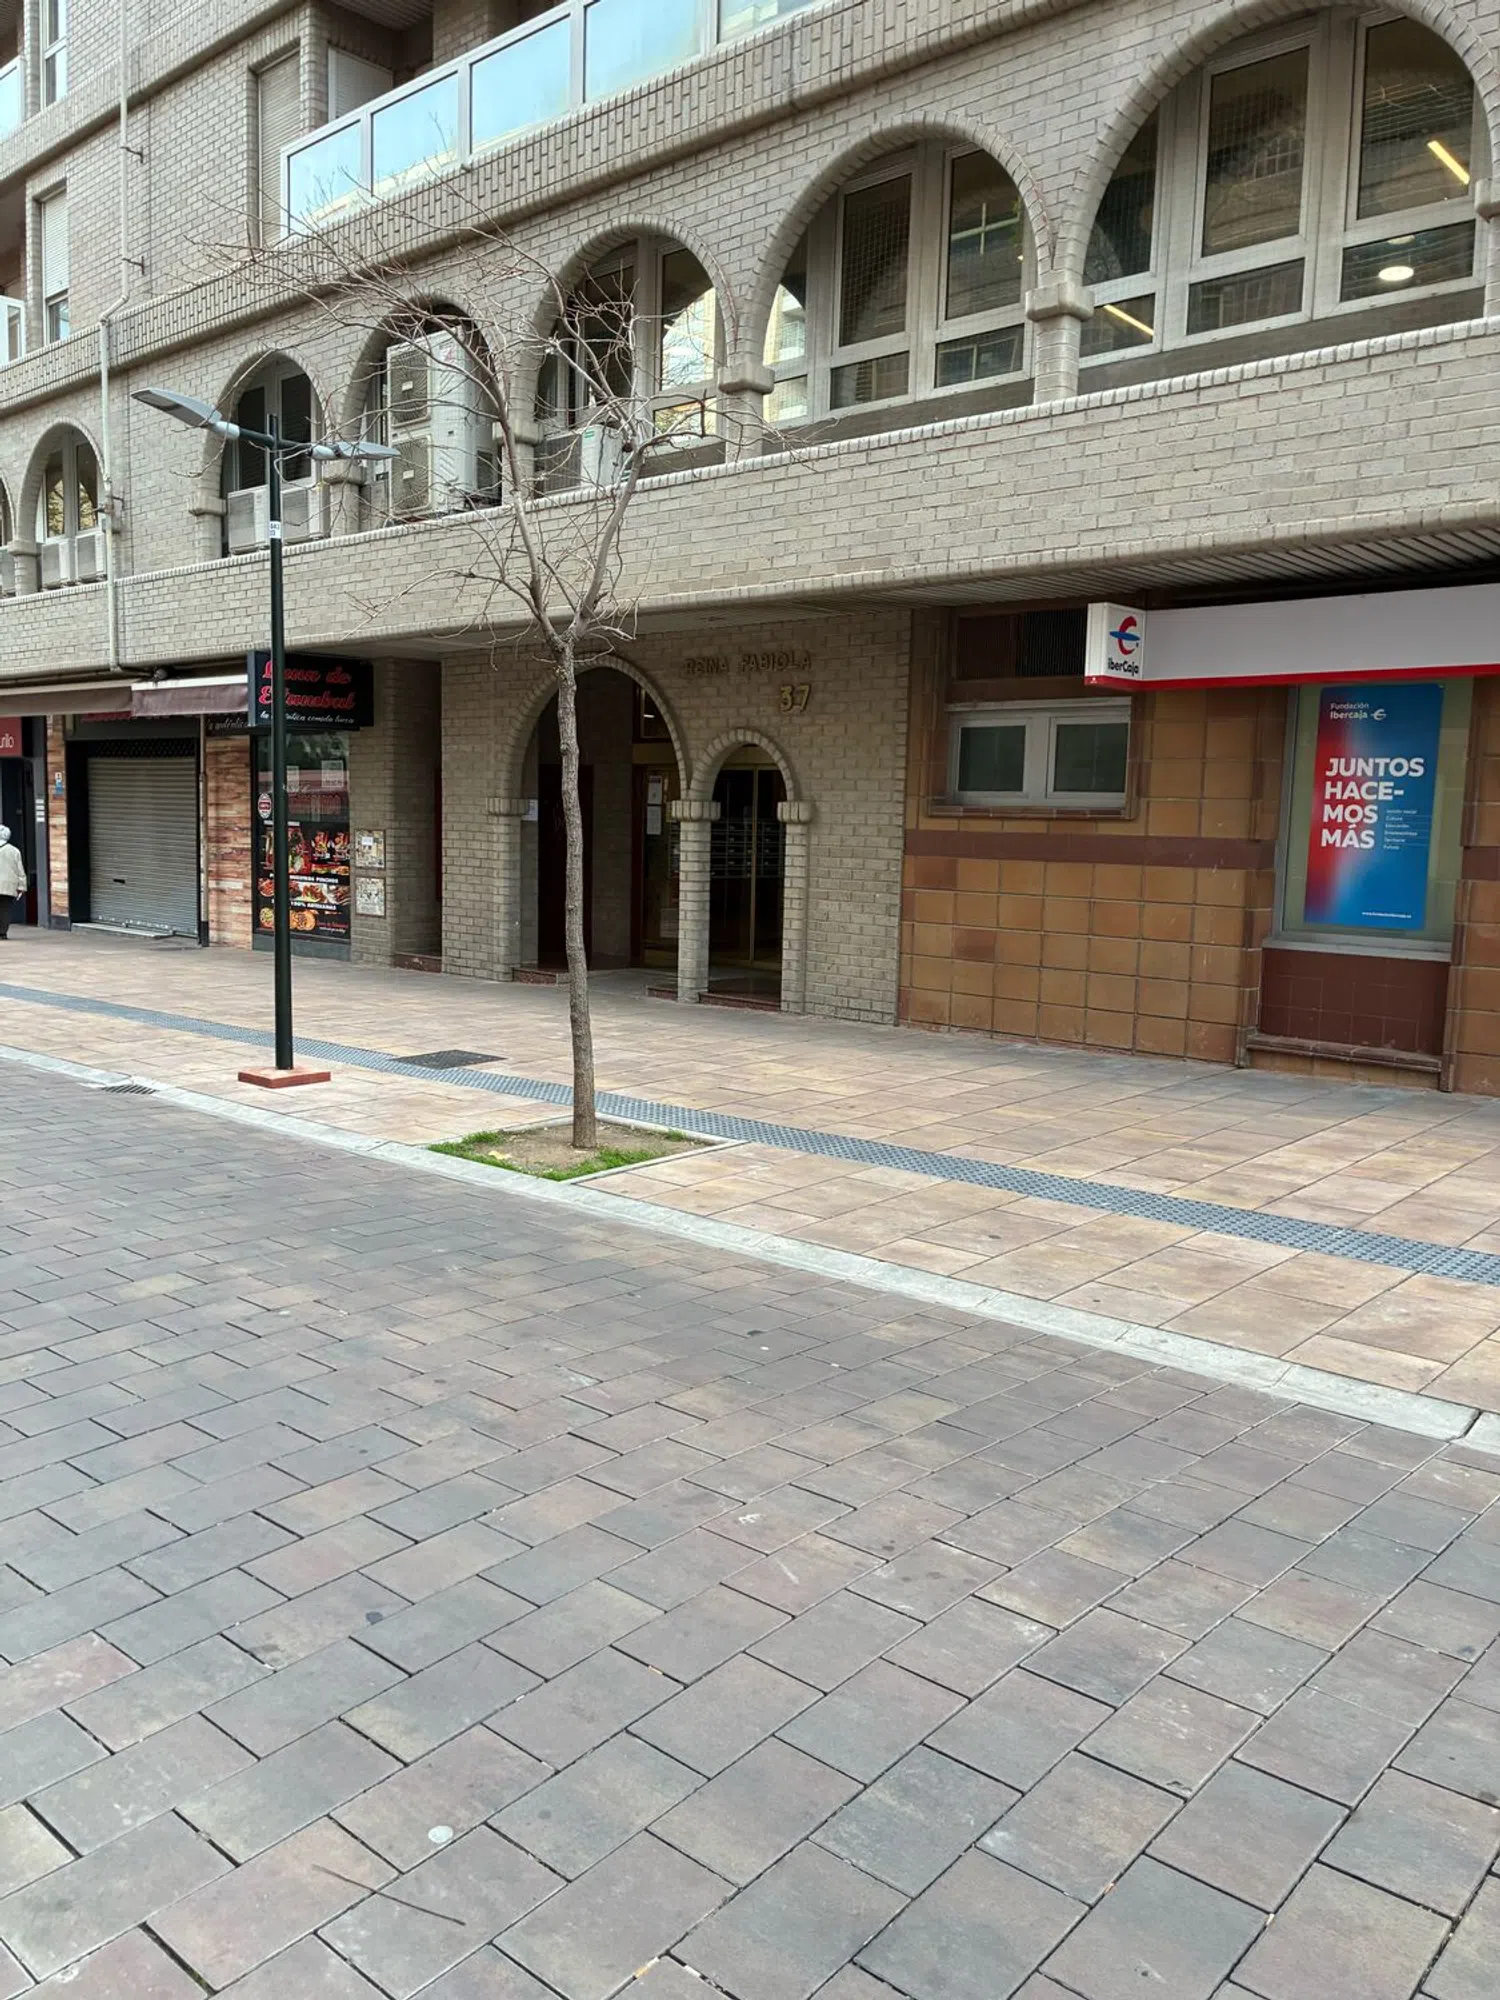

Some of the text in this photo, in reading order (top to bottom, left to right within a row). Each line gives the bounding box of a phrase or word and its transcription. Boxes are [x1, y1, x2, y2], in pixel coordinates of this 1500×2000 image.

[683, 650, 812, 675] REINA FABIOLA
[780, 683, 812, 713] 37
[1330, 702, 1370, 710] Fundación
[1330, 710, 1368, 721] Ibercaja
[1325, 757, 1425, 778] JUNTOS
[1324, 781, 1404, 801] HACE-
[1322, 804, 1379, 824] MOS
[1320, 823, 1376, 850] MÁS
